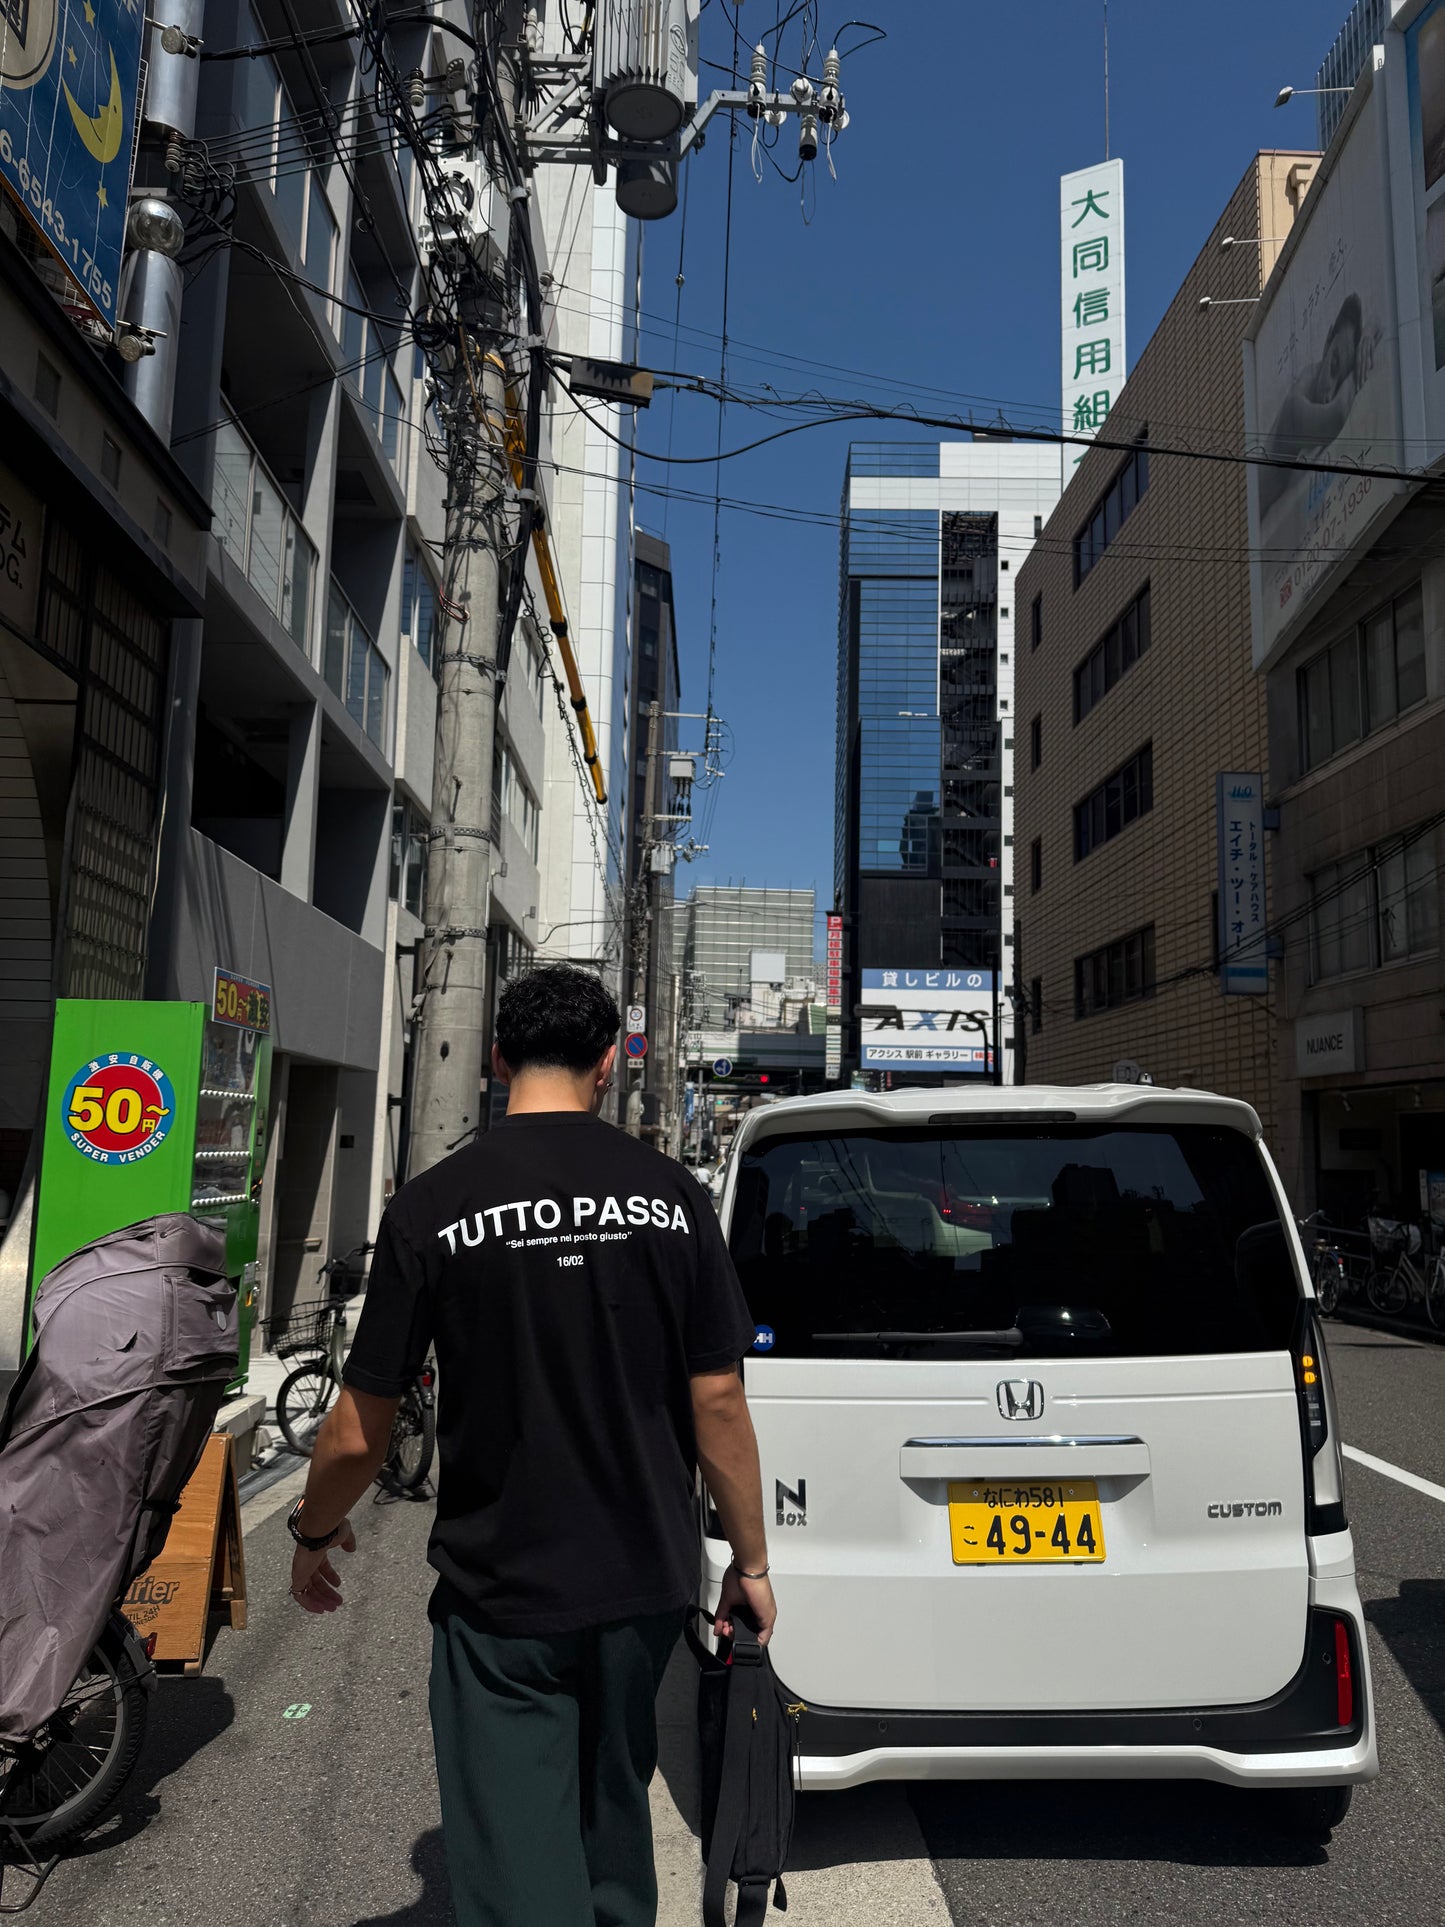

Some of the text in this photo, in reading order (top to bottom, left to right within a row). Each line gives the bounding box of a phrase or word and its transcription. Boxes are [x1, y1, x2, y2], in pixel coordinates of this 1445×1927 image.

[1071, 190, 1110, 465] 大同信用組
[1229, 821, 1245, 948] エイチ・ツー・オー
[882, 971, 983, 988] 貸しビルの
[874, 1010, 989, 1031] AXIS
[1306, 1033, 1343, 1054] NUANCE
[868, 1049, 903, 1058] アクシス
[905, 1050, 923, 1059] 駅前
[925, 1051, 968, 1060] ギャラリー
[71, 1130, 166, 1163] SUPER VENDER
[437, 1195, 690, 1255] TUTTO PASSA
[526, 1234, 558, 1246] sempre
[560, 1233, 572, 1242] nel
[573, 1232, 597, 1243] posto
[556, 1255, 584, 1267] 16/02
[776, 1479, 806, 1510] N
[1208, 1501, 1282, 1519] CUSTOM
[963, 1514, 1096, 1556] こ 49-44
